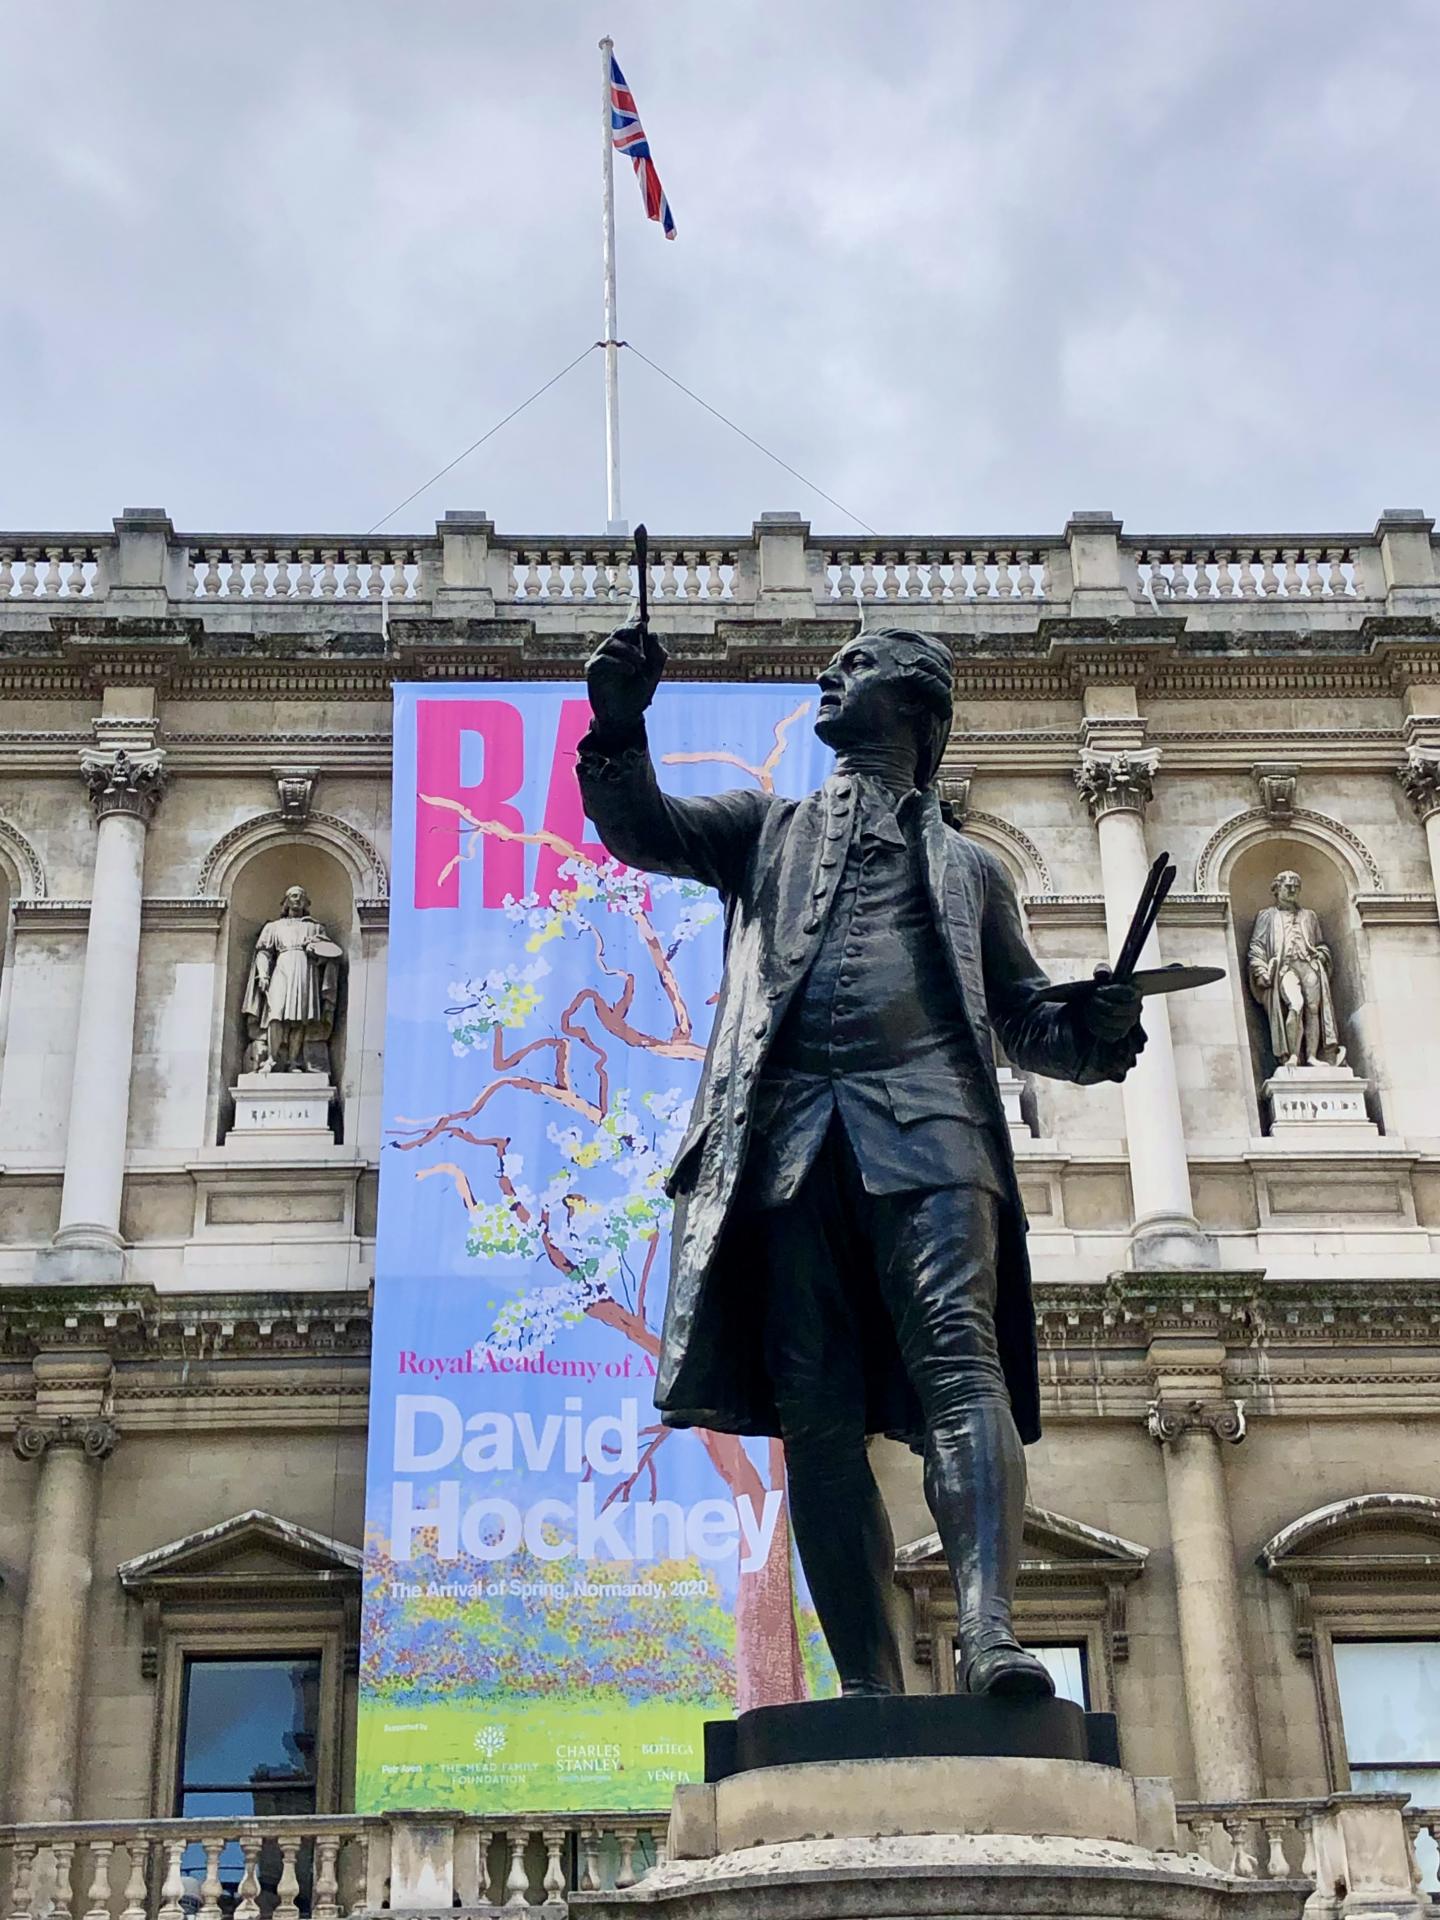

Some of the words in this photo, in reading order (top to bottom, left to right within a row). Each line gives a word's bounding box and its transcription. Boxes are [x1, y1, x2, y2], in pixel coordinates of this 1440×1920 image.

[399, 1350, 473, 1381] Royal
[478, 1349, 601, 1383] Academy
[605, 1354, 632, 1378] of
[393, 1394, 639, 1474] David
[391, 1480, 783, 1573] Hockney
[390, 1582, 421, 1598] The
[426, 1580, 483, 1598] Arrival
[486, 1581, 507, 1597] of
[510, 1580, 569, 1600] Spring,
[574, 1580, 667, 1599] Normandy,
[670, 1580, 709, 1596] 2020
[556, 1744, 621, 1758] CHARLES
[641, 1743, 693, 1755] BOTTEGA
[440, 1764, 460, 1774] THE
[502, 1762, 539, 1772] FAMILY
[556, 1759, 621, 1772] STANLEY
[453, 1775, 526, 1785] FOUNDATION
[647, 1770, 690, 1783] VENETA
